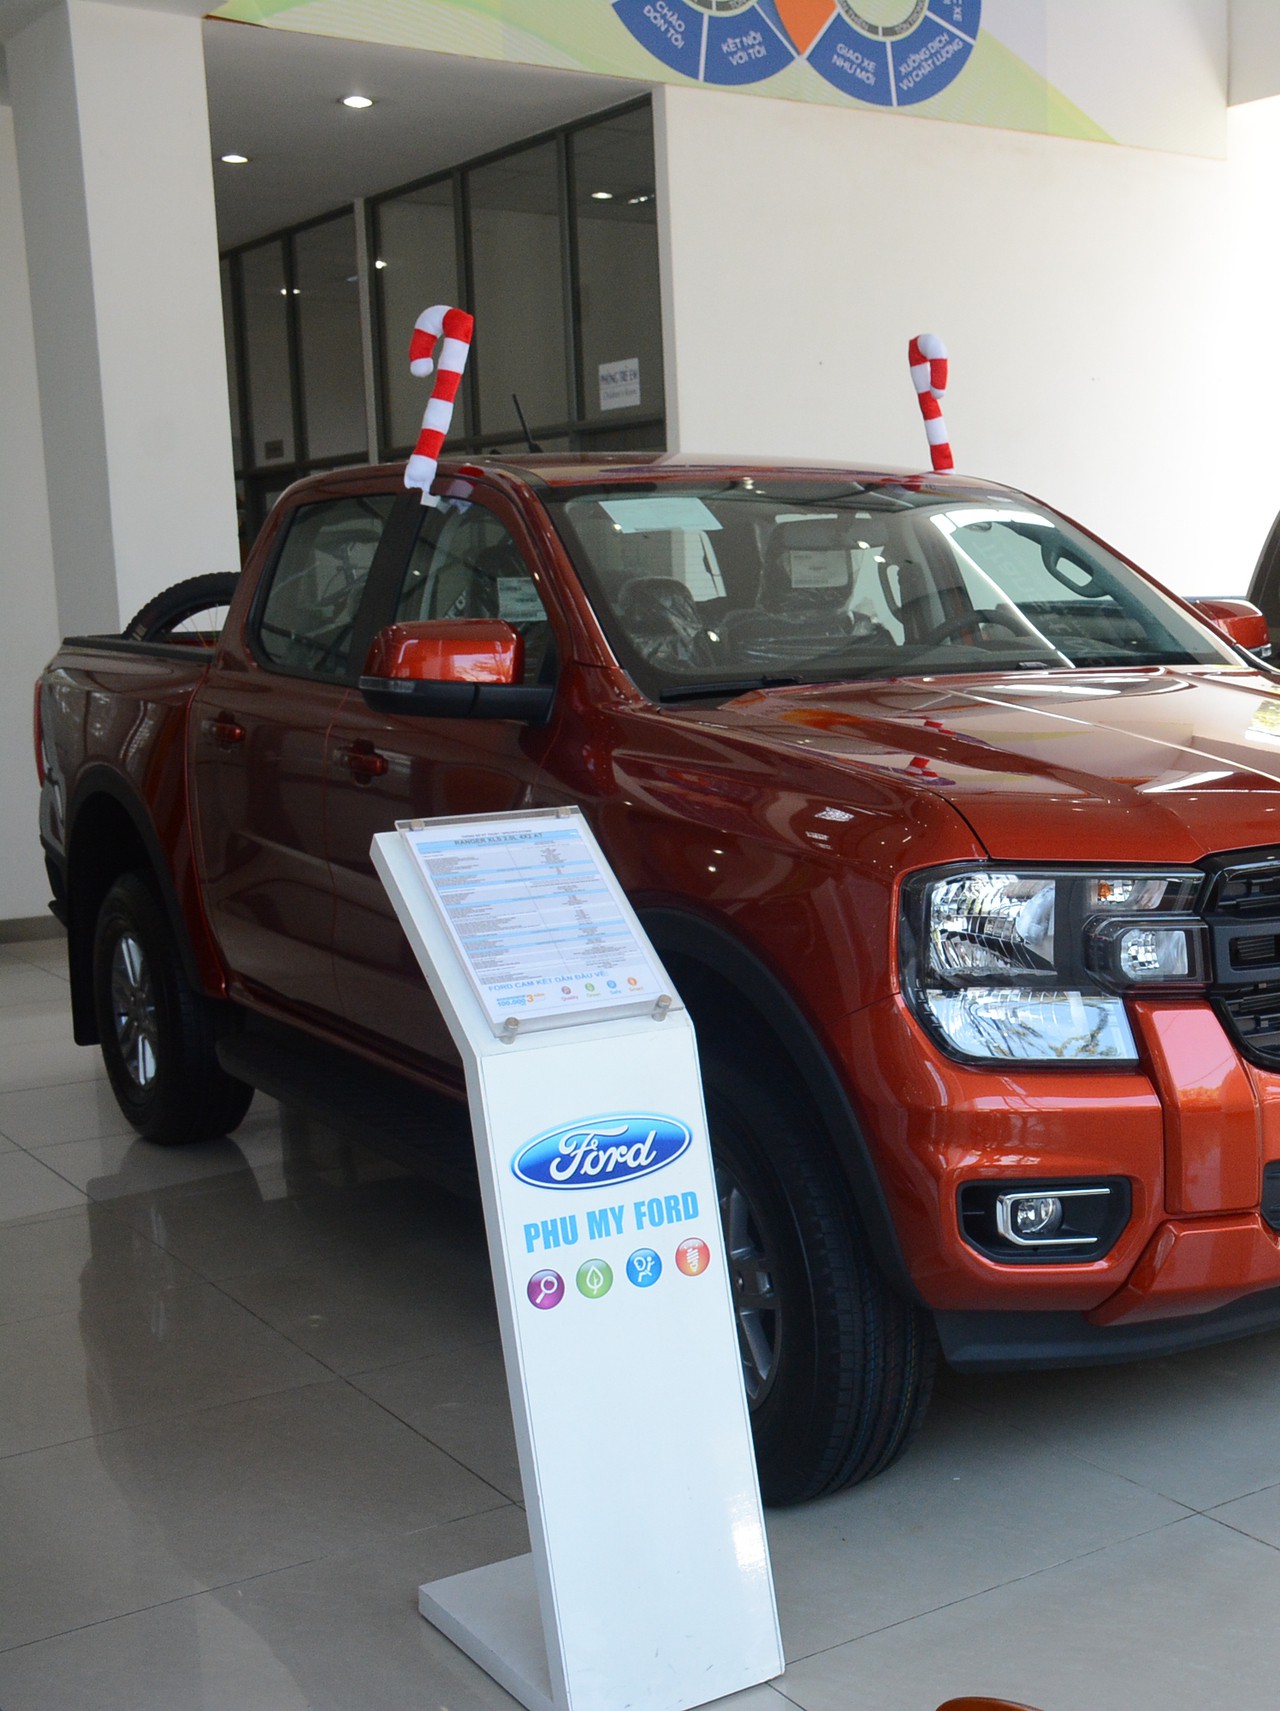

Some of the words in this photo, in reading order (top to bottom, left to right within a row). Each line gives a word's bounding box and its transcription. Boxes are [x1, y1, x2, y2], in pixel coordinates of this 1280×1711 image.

[488, 983, 513, 992] FORD
[549, 1125, 657, 1181] Ford
[523, 1215, 579, 1253] PHU
[586, 1205, 625, 1241] MY
[633, 1191, 700, 1230] FORD
